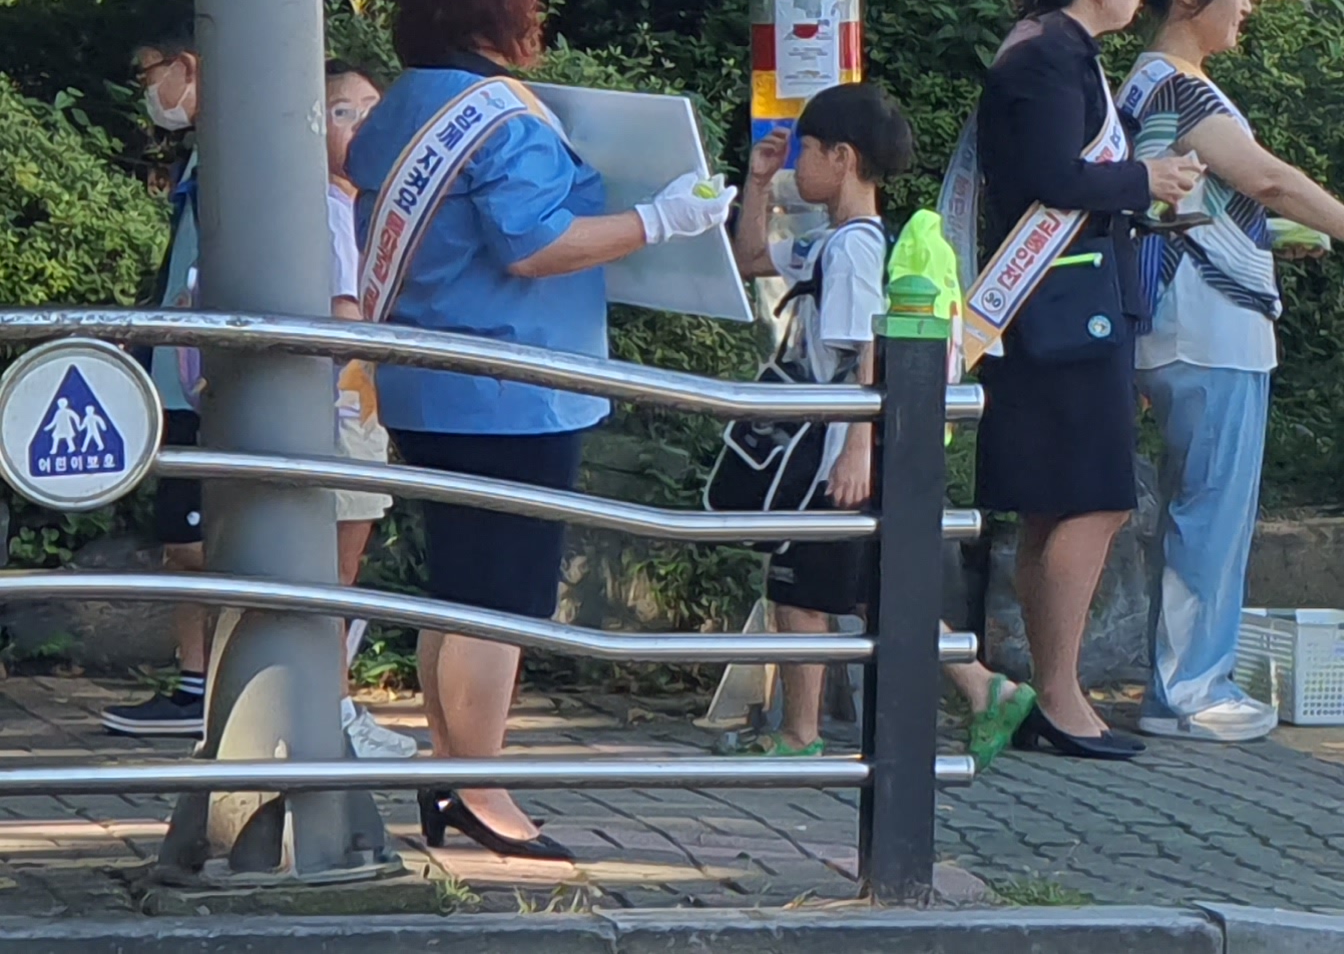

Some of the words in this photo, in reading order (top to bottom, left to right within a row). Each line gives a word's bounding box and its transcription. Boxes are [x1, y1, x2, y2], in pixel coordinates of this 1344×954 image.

[435, 104, 483, 151] 함께
[392, 145, 444, 216] 지켜요
[38, 453, 116, 473] 어린이보호
